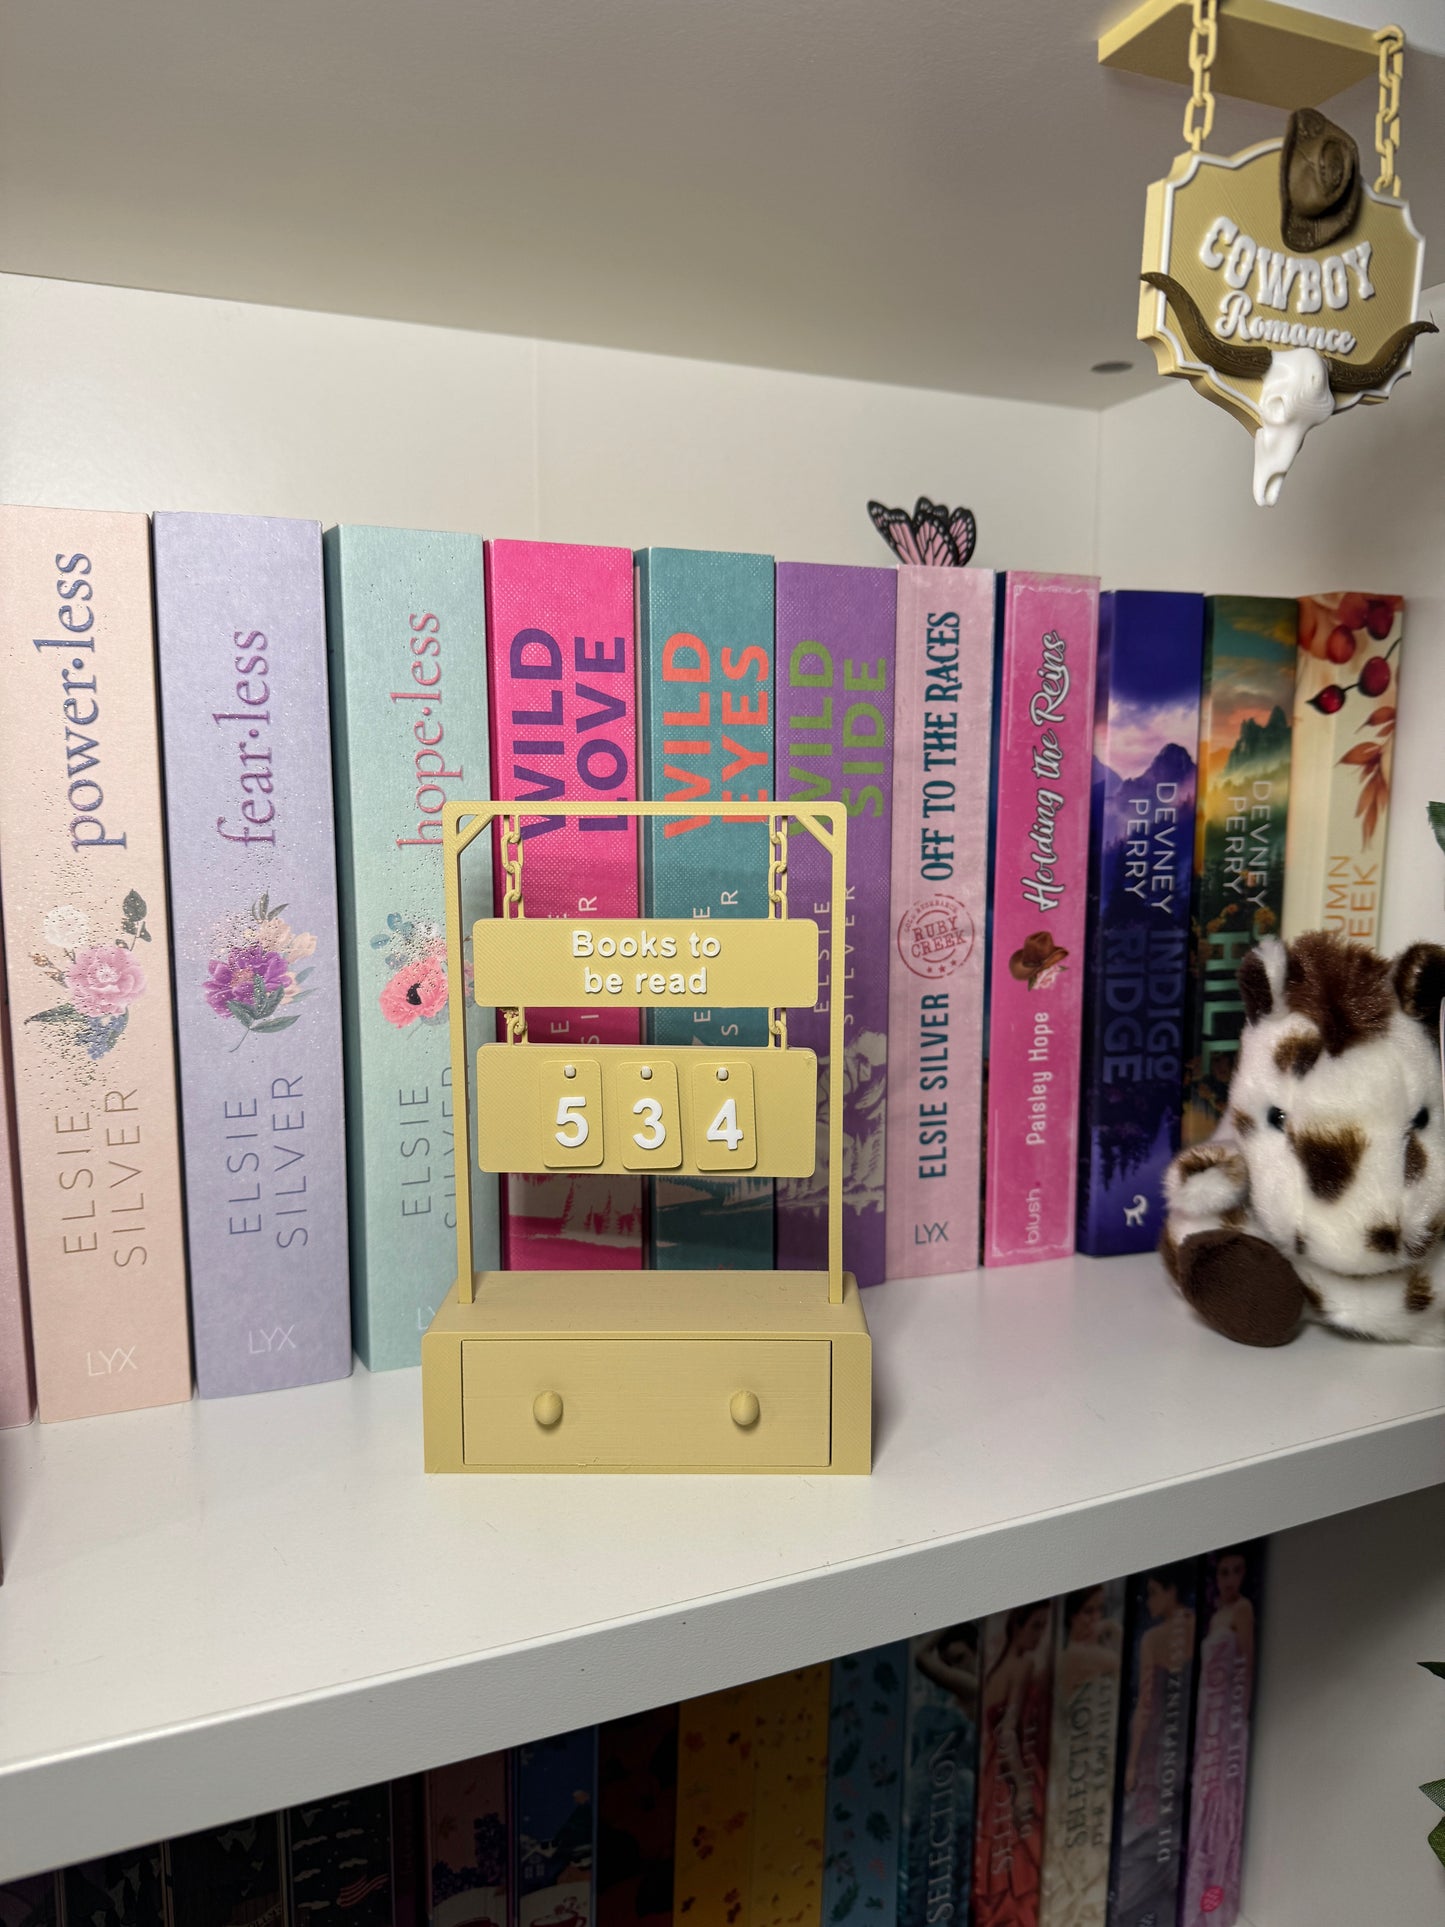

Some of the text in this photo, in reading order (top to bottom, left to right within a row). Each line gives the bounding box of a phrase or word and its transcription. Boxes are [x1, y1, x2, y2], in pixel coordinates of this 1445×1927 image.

[1200, 216, 1376, 315] COWBOY
[1215, 290, 1357, 355] Romance
[510, 628, 566, 840] WILD
[574, 637, 629, 831] LOVE
[662, 632, 711, 839] WILD
[721, 645, 770, 824] EYES
[789, 639, 834, 837] WILD
[842, 658, 887, 818] SIDE
[920, 611, 961, 882] OFF TO THE RACES
[1023, 630, 1072, 913] Holding the Reins
[1123, 798, 1151, 902] PERRY
[1150, 781, 1179, 915] DEVNEY
[1221, 796, 1248, 897] PERRY
[1245, 780, 1272, 908] DEVNEY
[571, 930, 722, 958] Books to
[584, 966, 708, 995] be read
[814, 901, 830, 1013] ELSIE
[911, 930, 967, 958] CREEK
[912, 916, 959, 942] RUBY
[1102, 928, 1147, 1085] RIDGE
[1146, 928, 1188, 1081] INDIGO
[919, 992, 950, 1180] ELSIE SILVER
[1025, 1011, 1055, 1147] Paisley Hope
[55, 1111, 98, 1254] ELSIE
[104, 1088, 148, 1268] SILVER
[224, 1098, 262, 1235] ELSIE
[271, 1076, 309, 1248] SILVER
[399, 1086, 432, 1216] ELSIE
[915, 1221, 950, 1246] LYX
[86, 1345, 139, 1377] LYX
[248, 1325, 297, 1355] LYX
[925, 1728, 965, 1925] SELECTION
[1065, 1682, 1093, 1849] SELECTION
